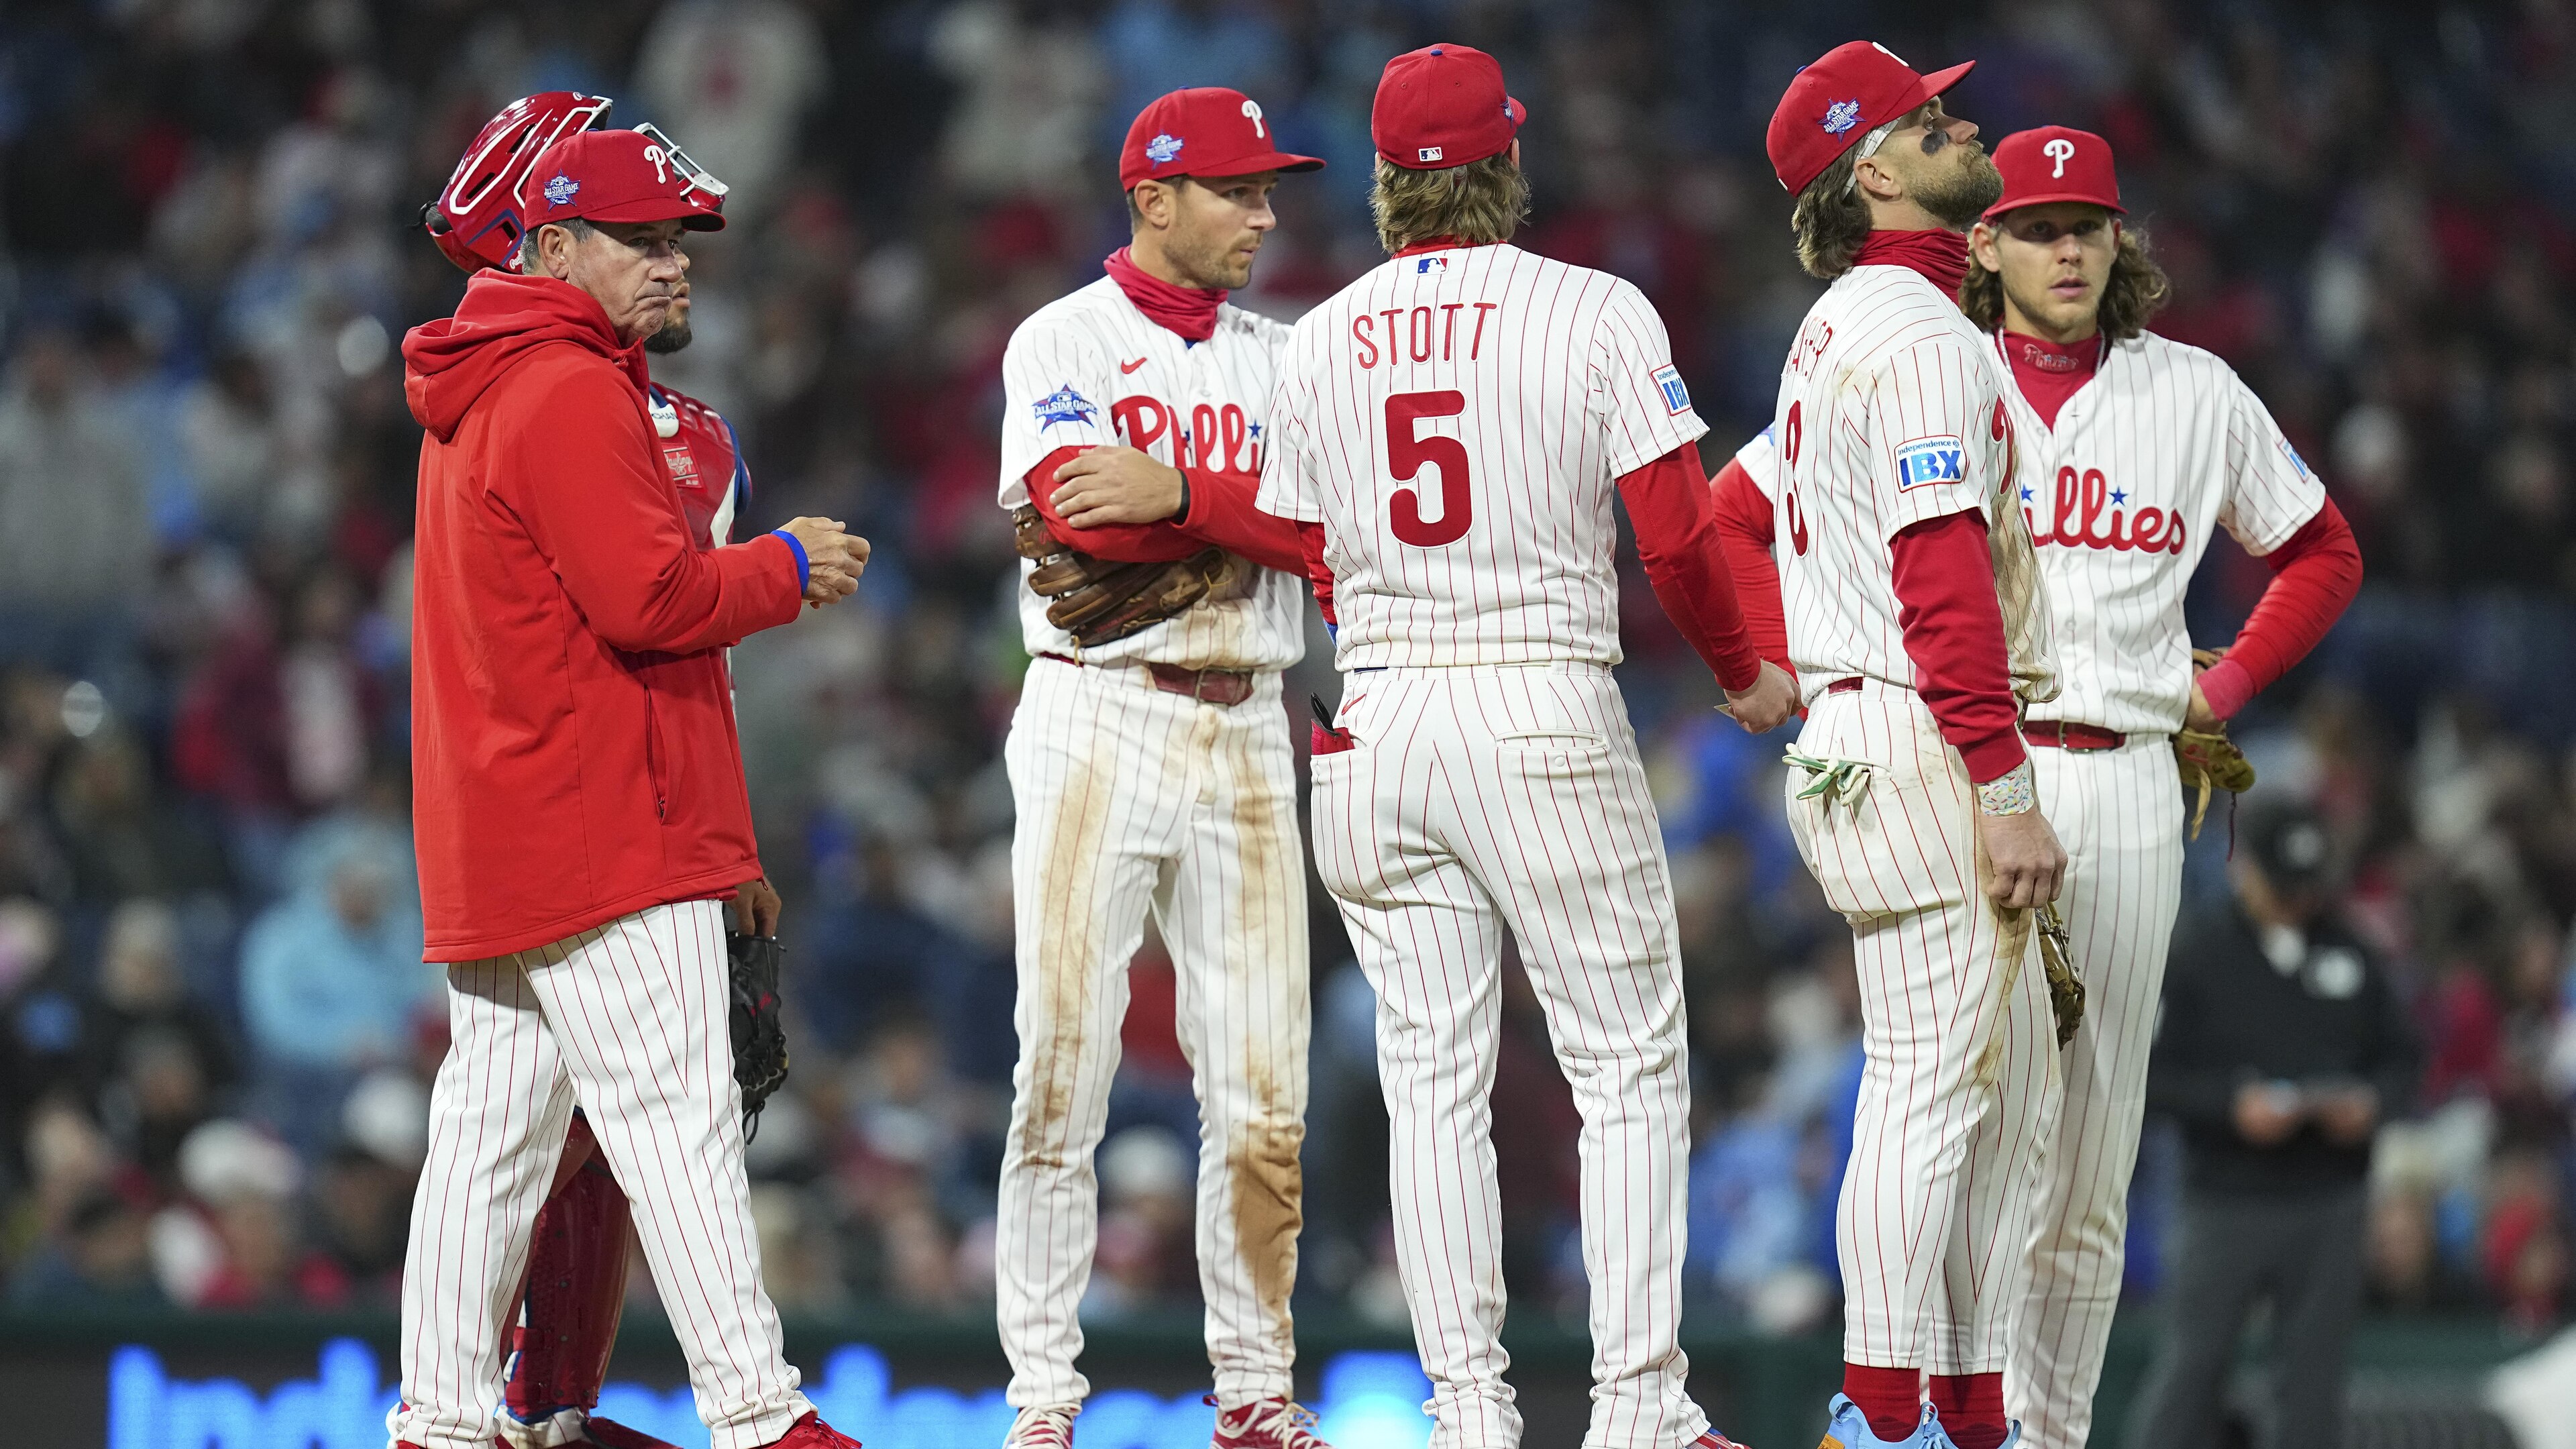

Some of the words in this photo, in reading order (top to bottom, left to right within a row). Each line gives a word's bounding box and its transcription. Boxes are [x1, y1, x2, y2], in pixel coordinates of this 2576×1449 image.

[1241, 99, 1265, 139] P
[1831, 111, 1847, 125] STAR
[1842, 100, 1859, 115] GAME
[644, 145, 666, 184] P
[2043, 138, 2076, 179] P
[552, 185, 565, 195] STAR
[565, 182, 579, 192] GAME
[1352, 303, 1497, 370] STOTT
[1050, 400, 1073, 412] STAR
[1662, 377, 1690, 411] IBX
[1897, 439, 1951, 456] Independence
[1385, 389, 1474, 548] 5
[1899, 450, 1962, 487] IBX
[2023, 465, 2186, 555] illies
